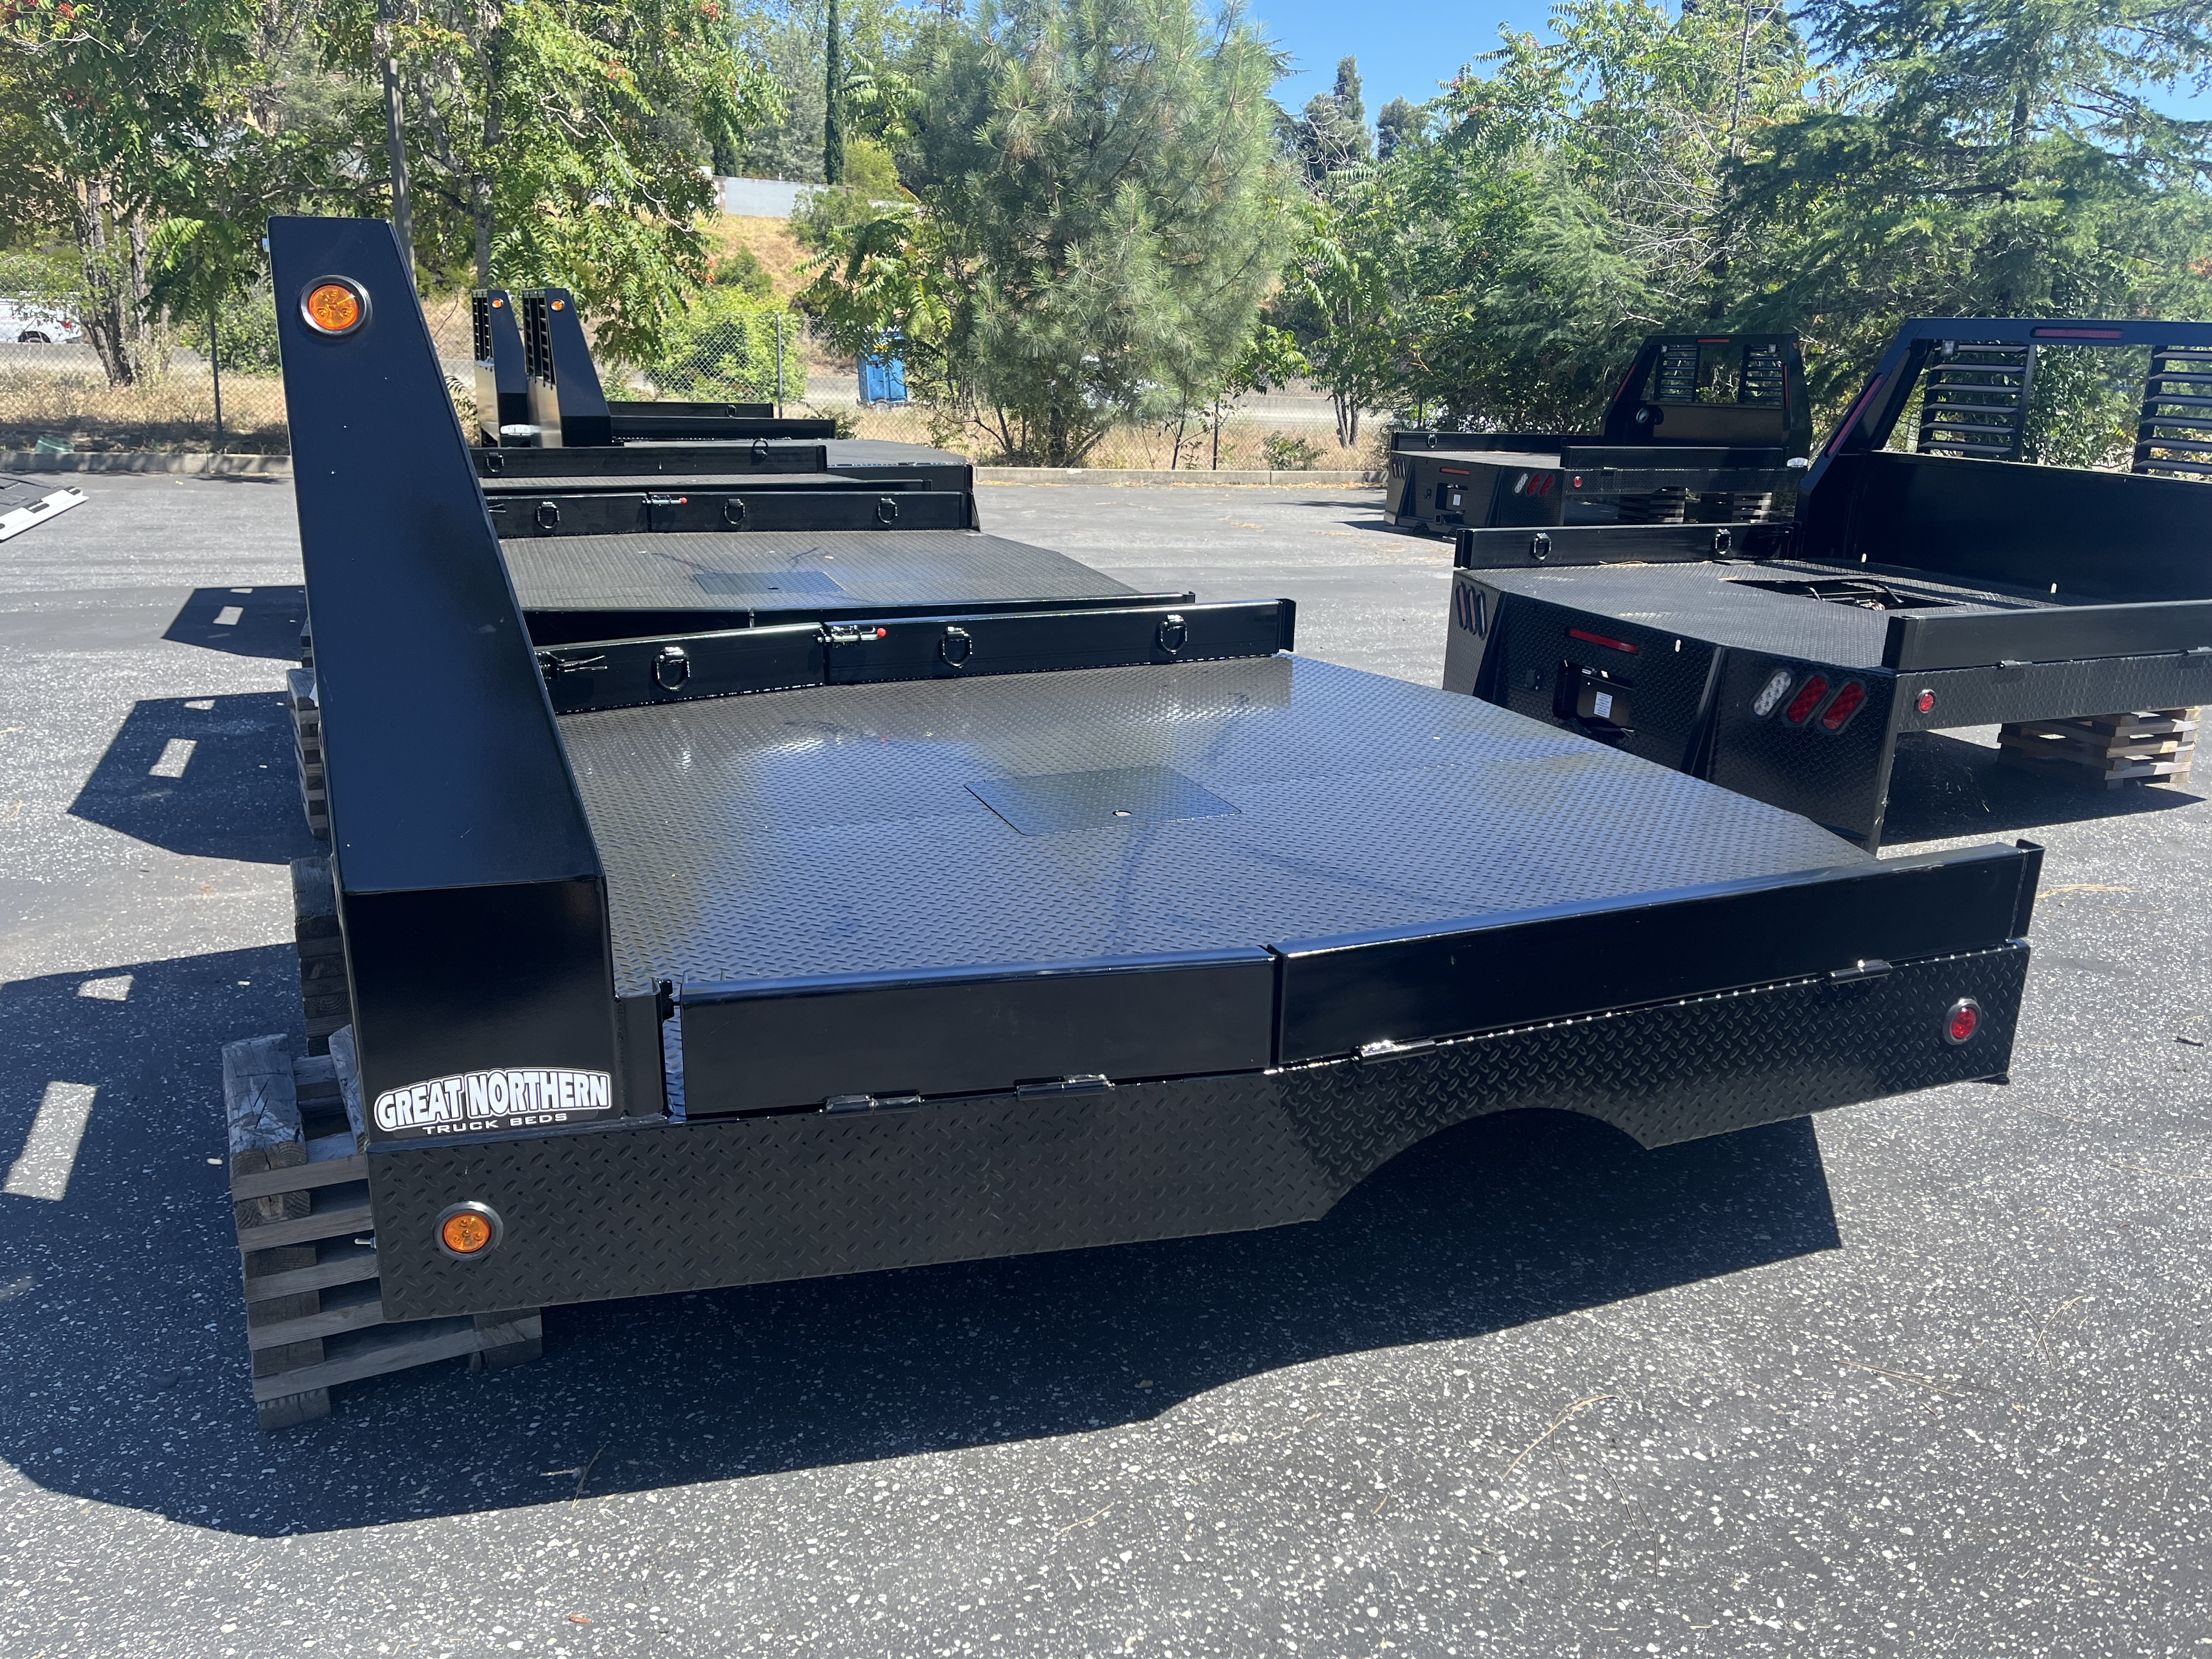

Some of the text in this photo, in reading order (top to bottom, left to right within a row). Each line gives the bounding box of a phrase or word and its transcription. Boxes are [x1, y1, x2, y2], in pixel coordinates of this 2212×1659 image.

[376, 1070, 610, 1130] GREAT NORTHERN
[422, 1113, 567, 1135] TRUCK BEDS
